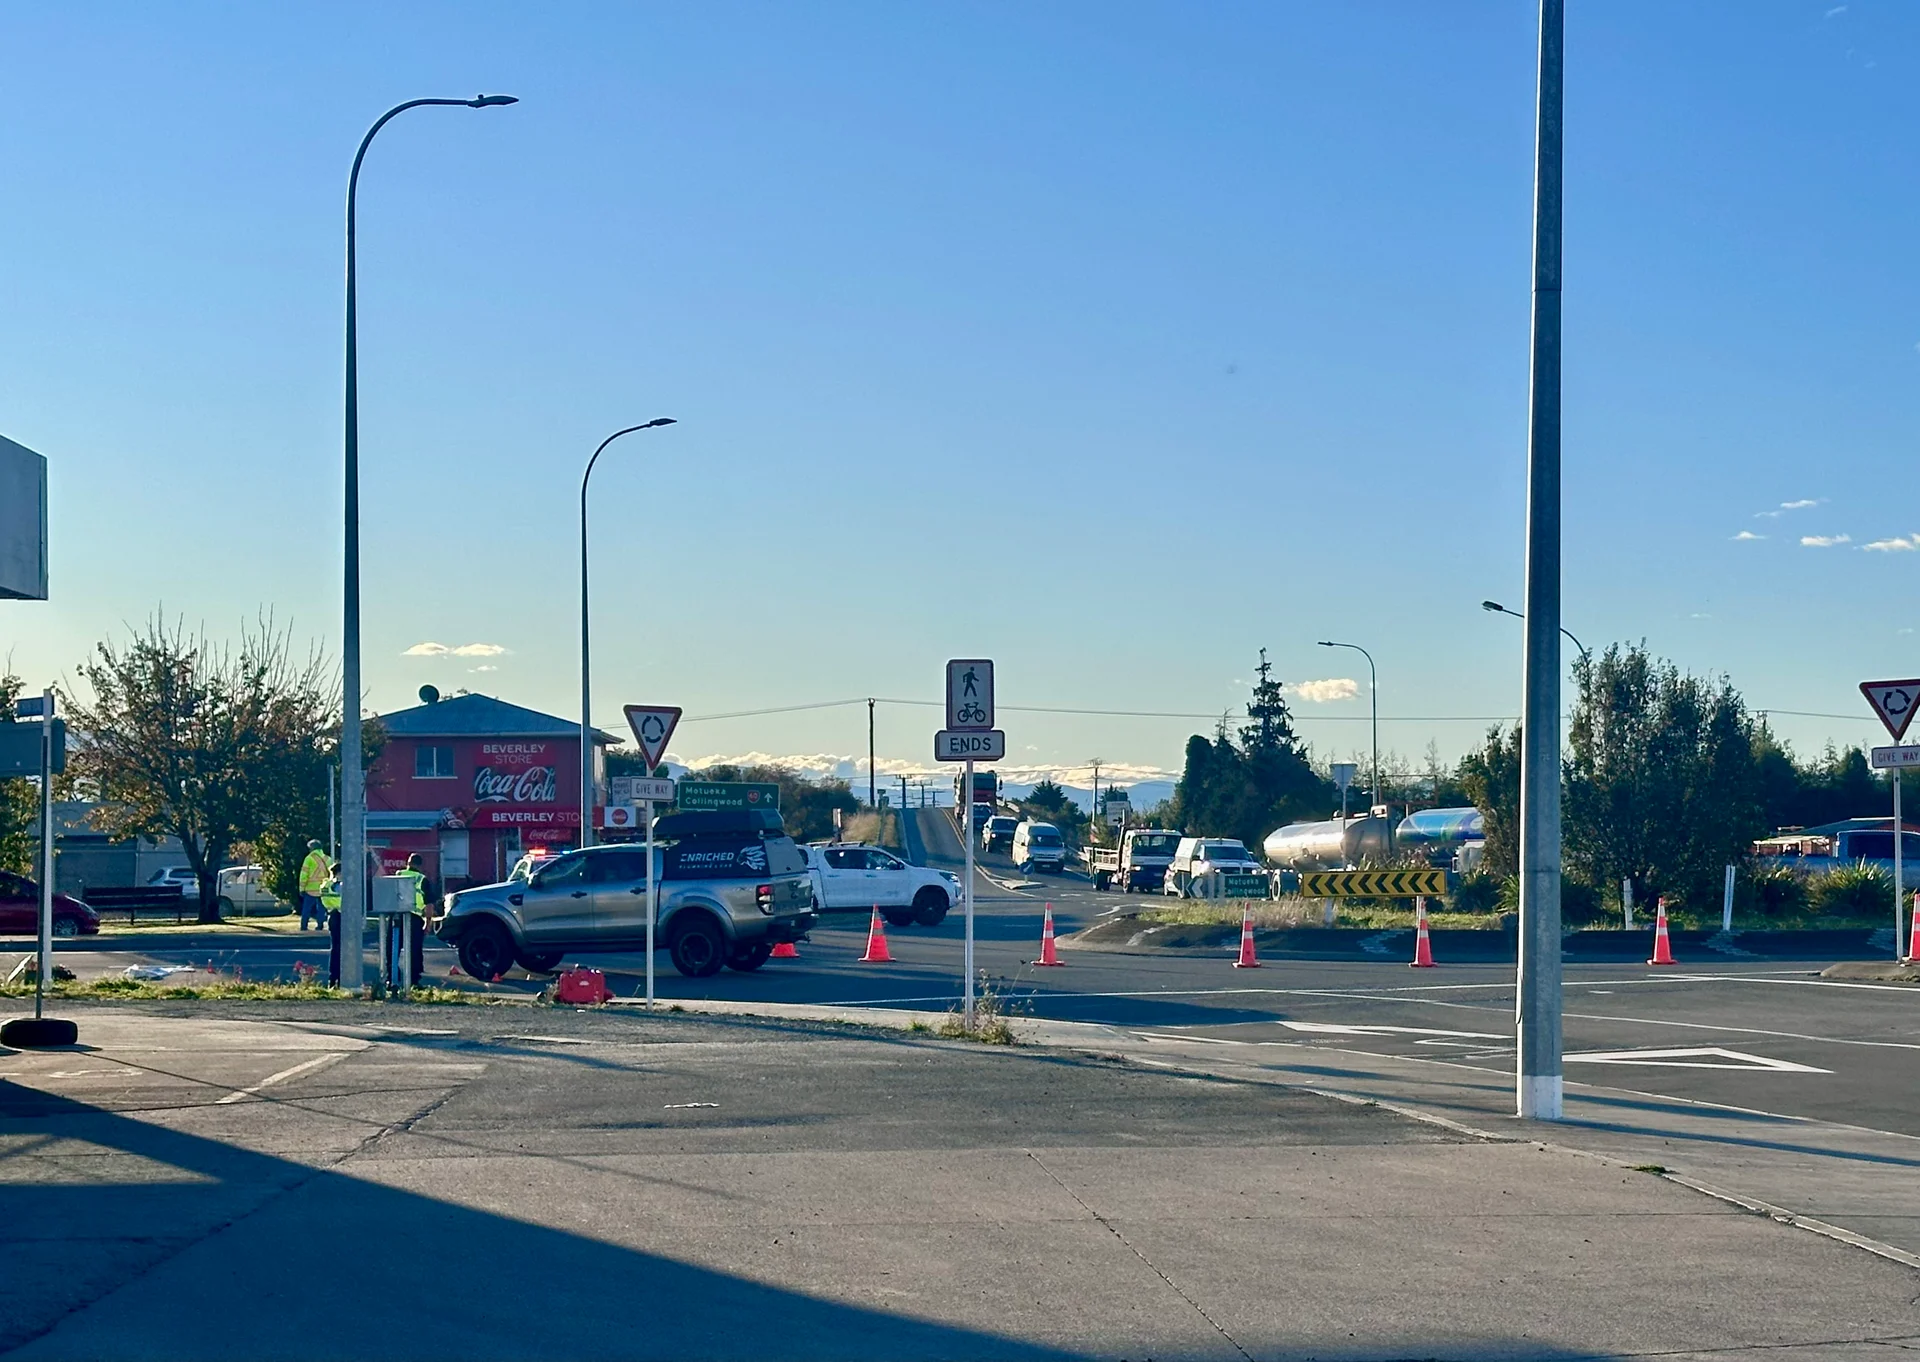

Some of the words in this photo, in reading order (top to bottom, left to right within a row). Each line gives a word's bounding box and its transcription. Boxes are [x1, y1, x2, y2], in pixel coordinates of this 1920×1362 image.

[483, 744, 546, 754] BEVERLEY
[950, 737, 991, 752] ENDS
[495, 754, 533, 764] STORE
[1878, 752, 1896, 762] GIVE
[1902, 752, 1919, 761] WAY
[474, 766, 556, 803] Coca-Cola
[636, 783, 651, 794] GIVE
[655, 784, 668, 794] WAY
[685, 787, 727, 795] Motueka
[685, 797, 743, 807] Collingwood
[492, 812, 555, 822] BEVERLEY
[680, 852, 735, 862] ENRICHED
